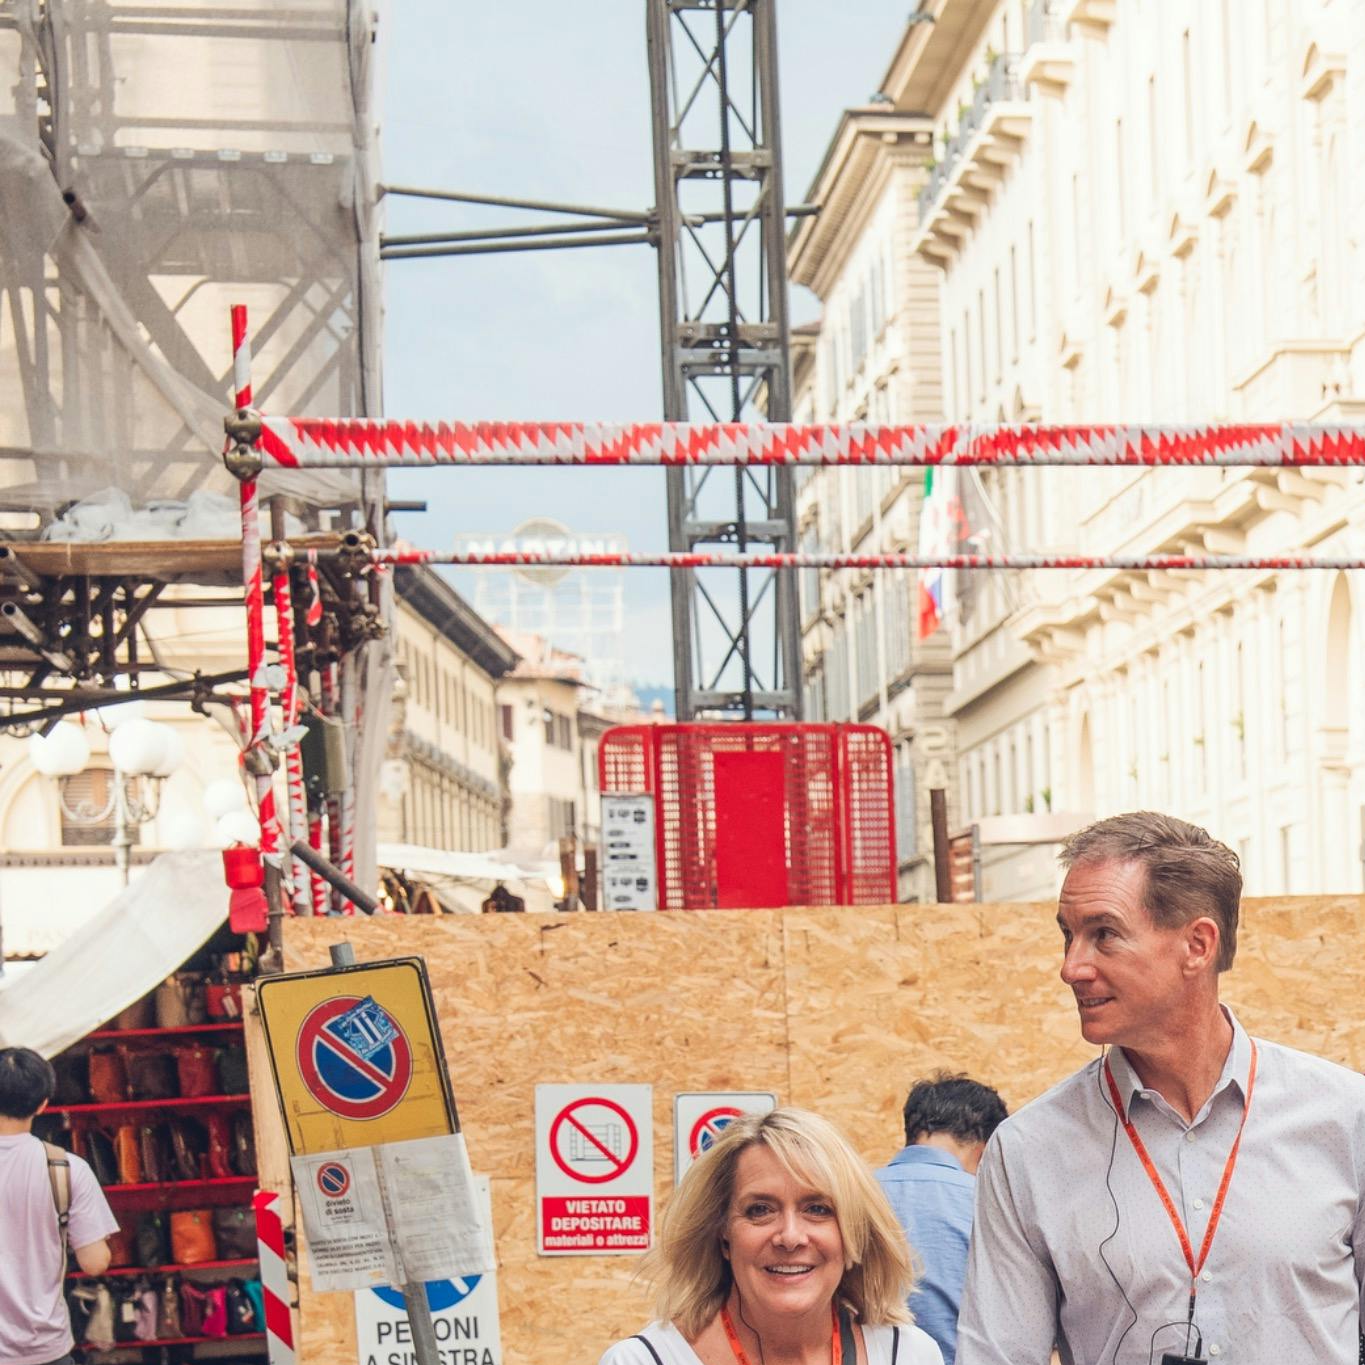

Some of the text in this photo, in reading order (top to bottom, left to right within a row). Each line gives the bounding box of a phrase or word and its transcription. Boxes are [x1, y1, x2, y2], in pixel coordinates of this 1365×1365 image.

[565, 1200, 626, 1214] VIETATO
[551, 1217, 641, 1231] DEPOSITARE
[545, 1233, 649, 1247] materiali o attrezzi
[377, 1316, 478, 1344] PEONI
